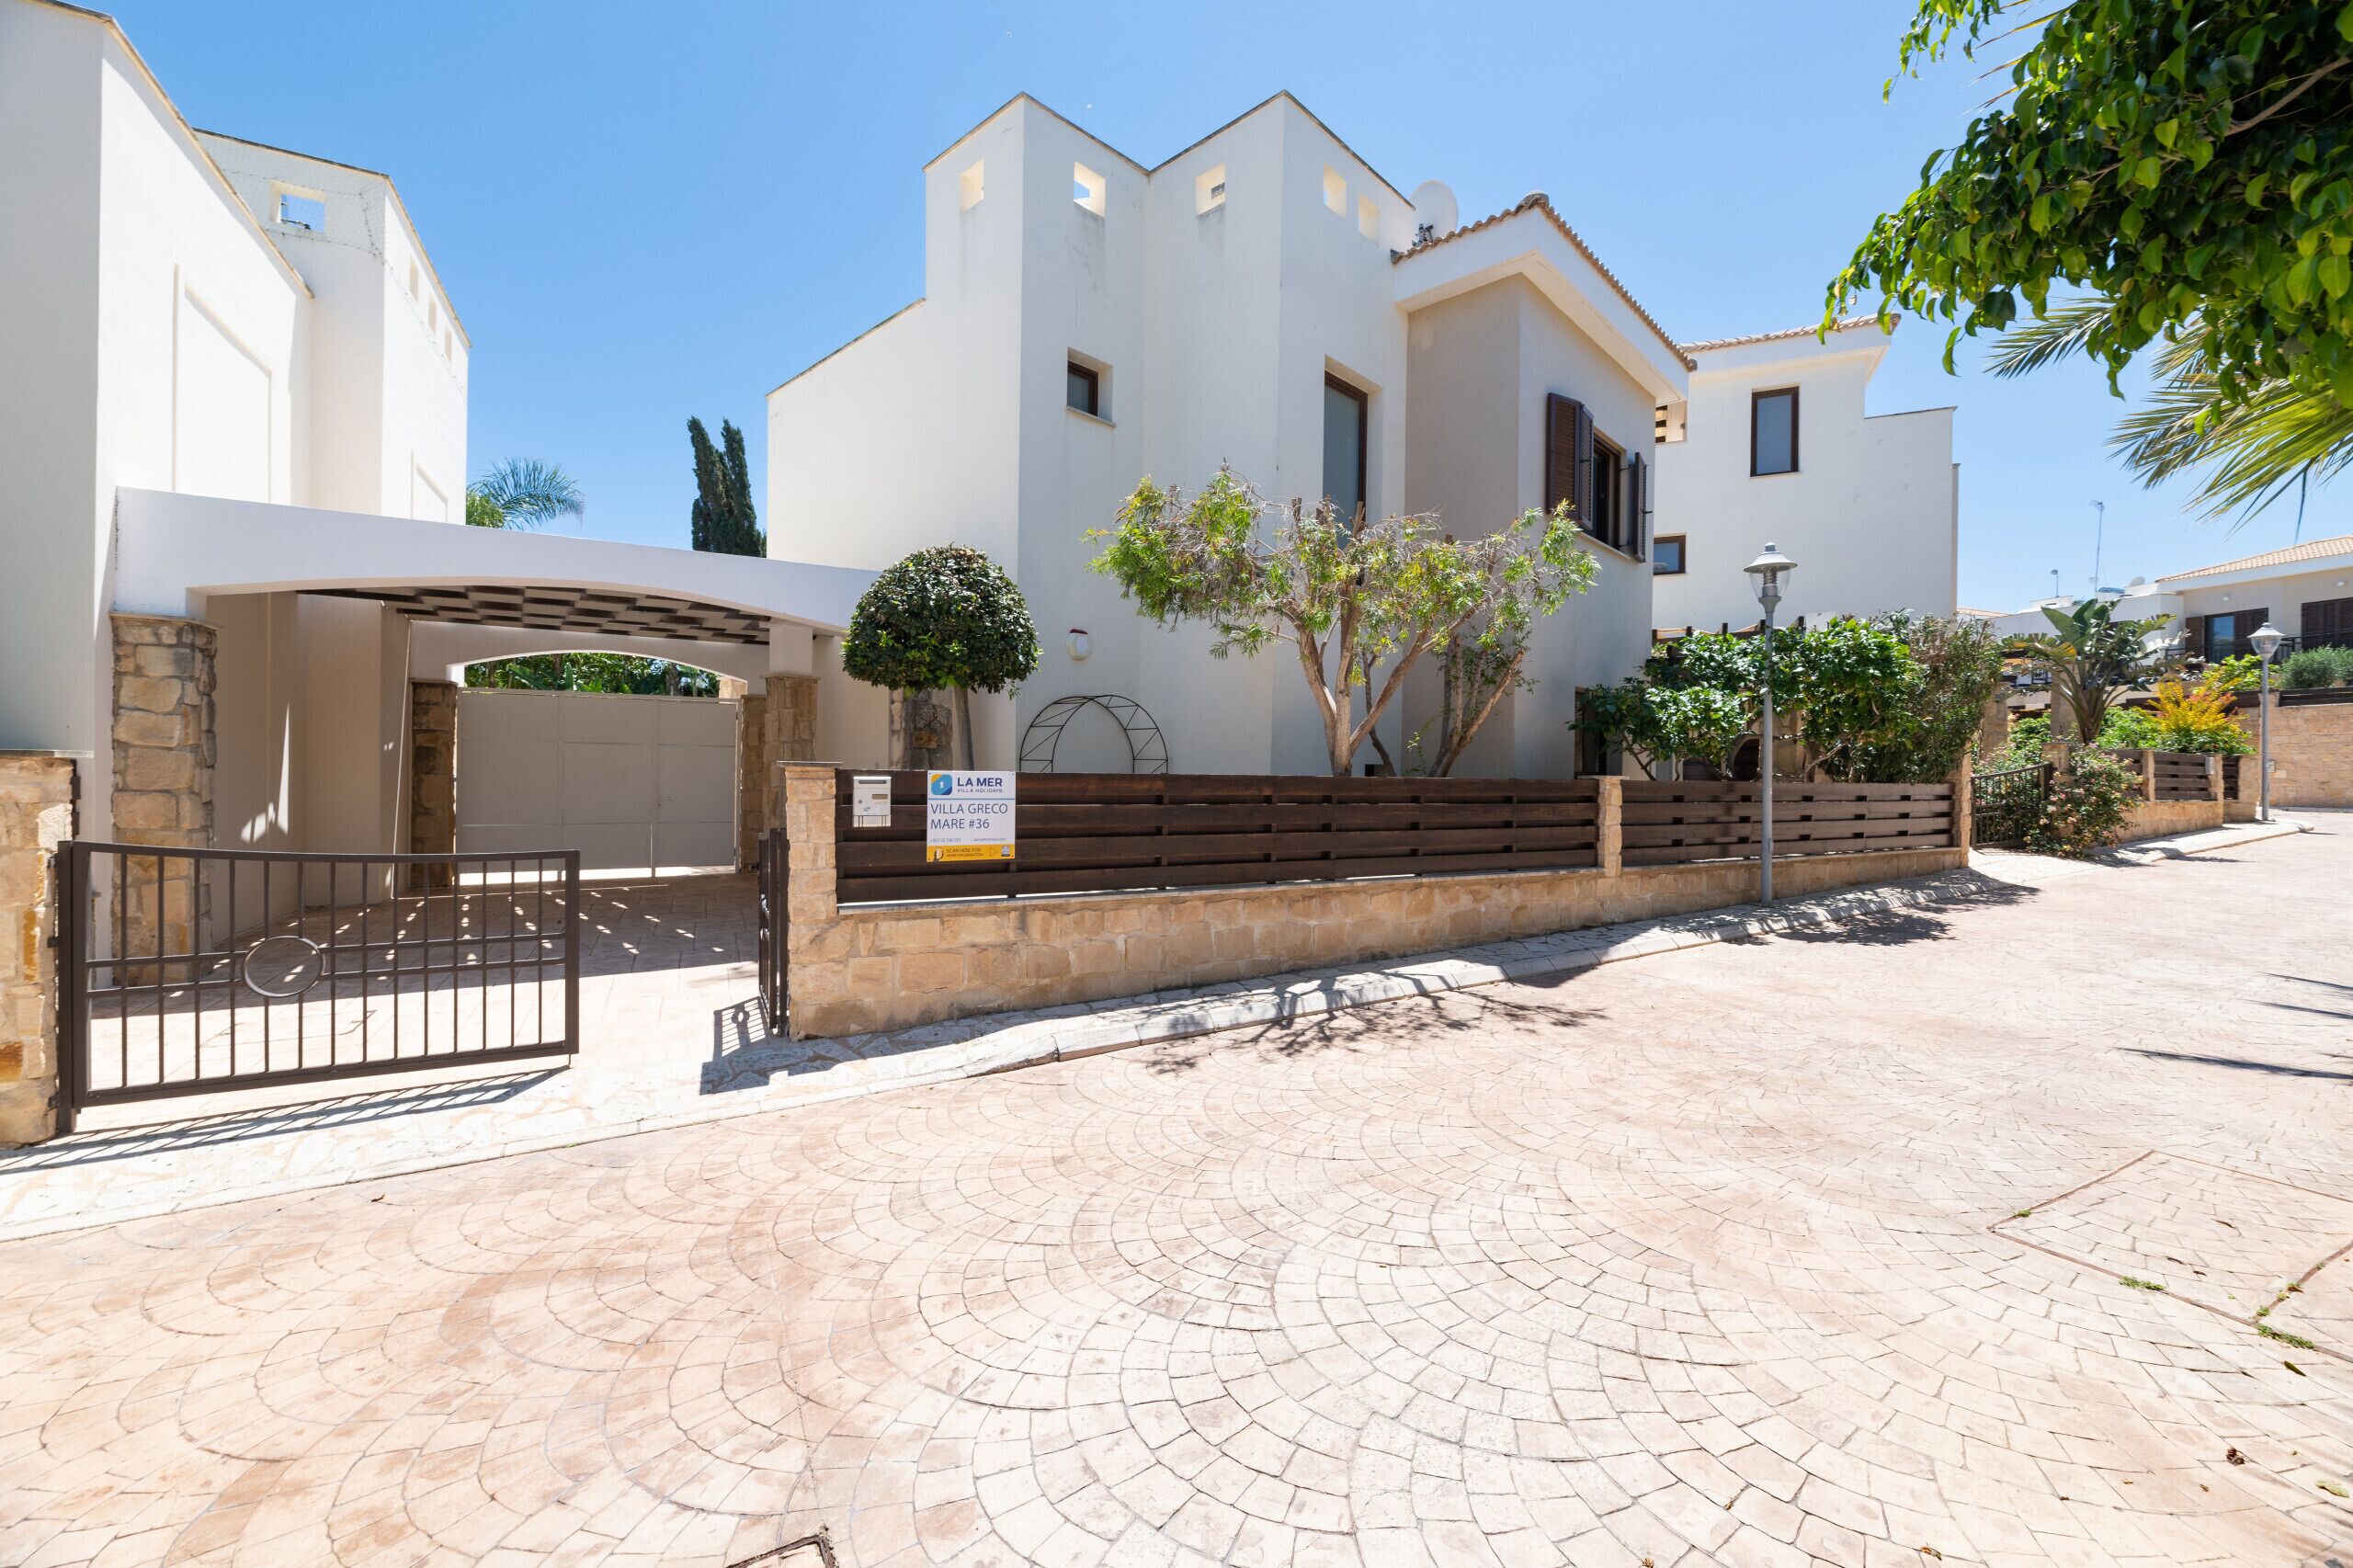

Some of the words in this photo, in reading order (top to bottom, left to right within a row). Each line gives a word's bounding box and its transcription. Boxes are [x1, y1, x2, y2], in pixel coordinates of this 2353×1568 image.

[957, 777, 973, 787] LA
[976, 777, 1003, 787] MER
[930, 803, 965, 814] VILLA
[967, 802, 1008, 814] GRECO
[930, 818, 965, 829] MARE
[968, 818, 990, 829] #36
